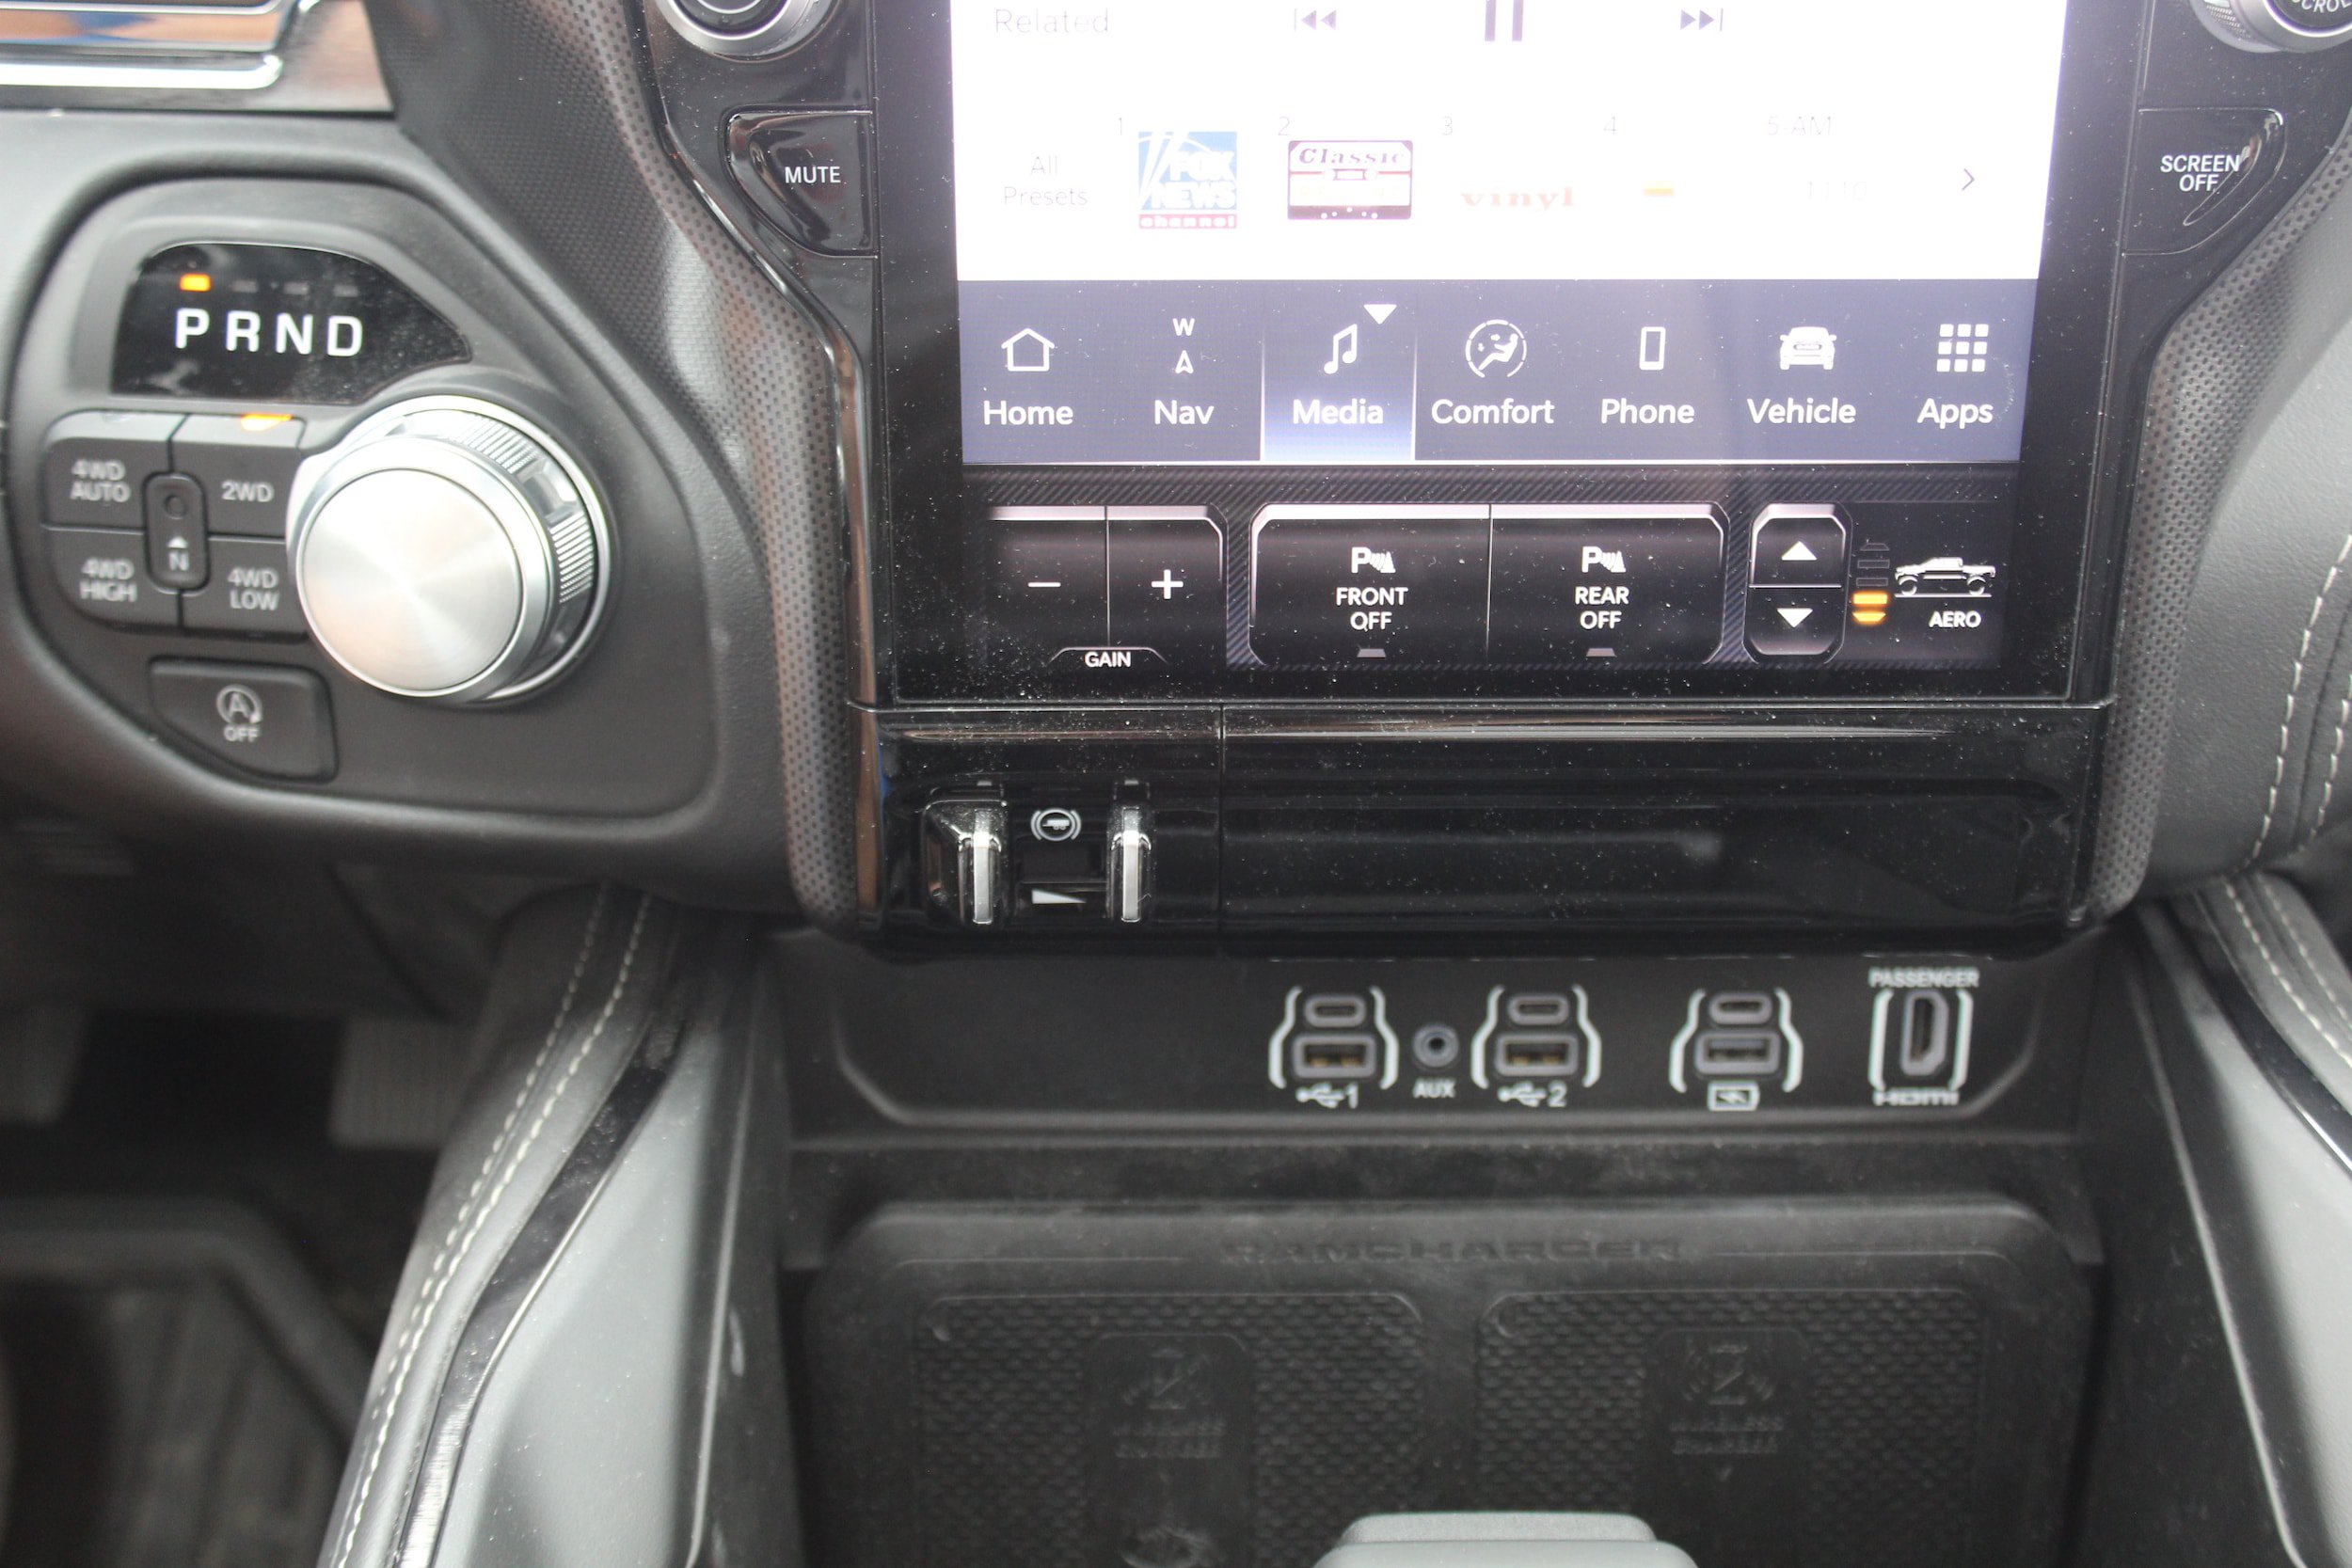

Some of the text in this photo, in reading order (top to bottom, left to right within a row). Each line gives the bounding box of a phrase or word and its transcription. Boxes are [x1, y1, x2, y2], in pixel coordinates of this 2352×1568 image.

[994, 8, 1108, 34] Related
[1277, 115, 1292, 136] 2
[1441, 115, 1454, 136] 3
[1602, 115, 1618, 136] 4
[1030, 155, 1058, 175] All
[1169, 150, 1235, 181] FOX
[1298, 148, 1405, 165] Classic
[2160, 154, 2240, 173] SCREEN
[785, 166, 842, 184] MUTE
[2179, 173, 2219, 193] OFF
[1003, 185, 1089, 206] Presets
[1150, 181, 1238, 210] NEWS
[1460, 186, 1574, 211] vinyl
[1172, 317, 1196, 337] W
[983, 400, 1074, 425] Home
[1153, 399, 1216, 425] Nav
[1292, 398, 1385, 425] Media
[1431, 397, 1556, 425] Comfort
[1600, 397, 1695, 424] Phone
[1746, 397, 1857, 424] Vehicle
[1916, 397, 1994, 430] Apps
[72, 459, 126, 482] 4WD
[70, 480, 131, 503] AUTO
[221, 480, 275, 503] 2WD
[81, 558, 135, 580] 4WD
[227, 567, 279, 590] 4WD
[79, 581, 137, 603] HIGH
[229, 590, 279, 611] LOW
[1335, 586, 1408, 607] FRONT
[1575, 585, 1629, 605] REAR
[1350, 610, 1392, 631] OFF
[1580, 610, 1623, 630] OFF
[1928, 610, 1982, 628] AERO
[1084, 651, 1132, 669] GAIN
[223, 725, 260, 742] OFF
[1868, 967, 1980, 988] PASSENGER
[1412, 1081, 1456, 1099] AUX
